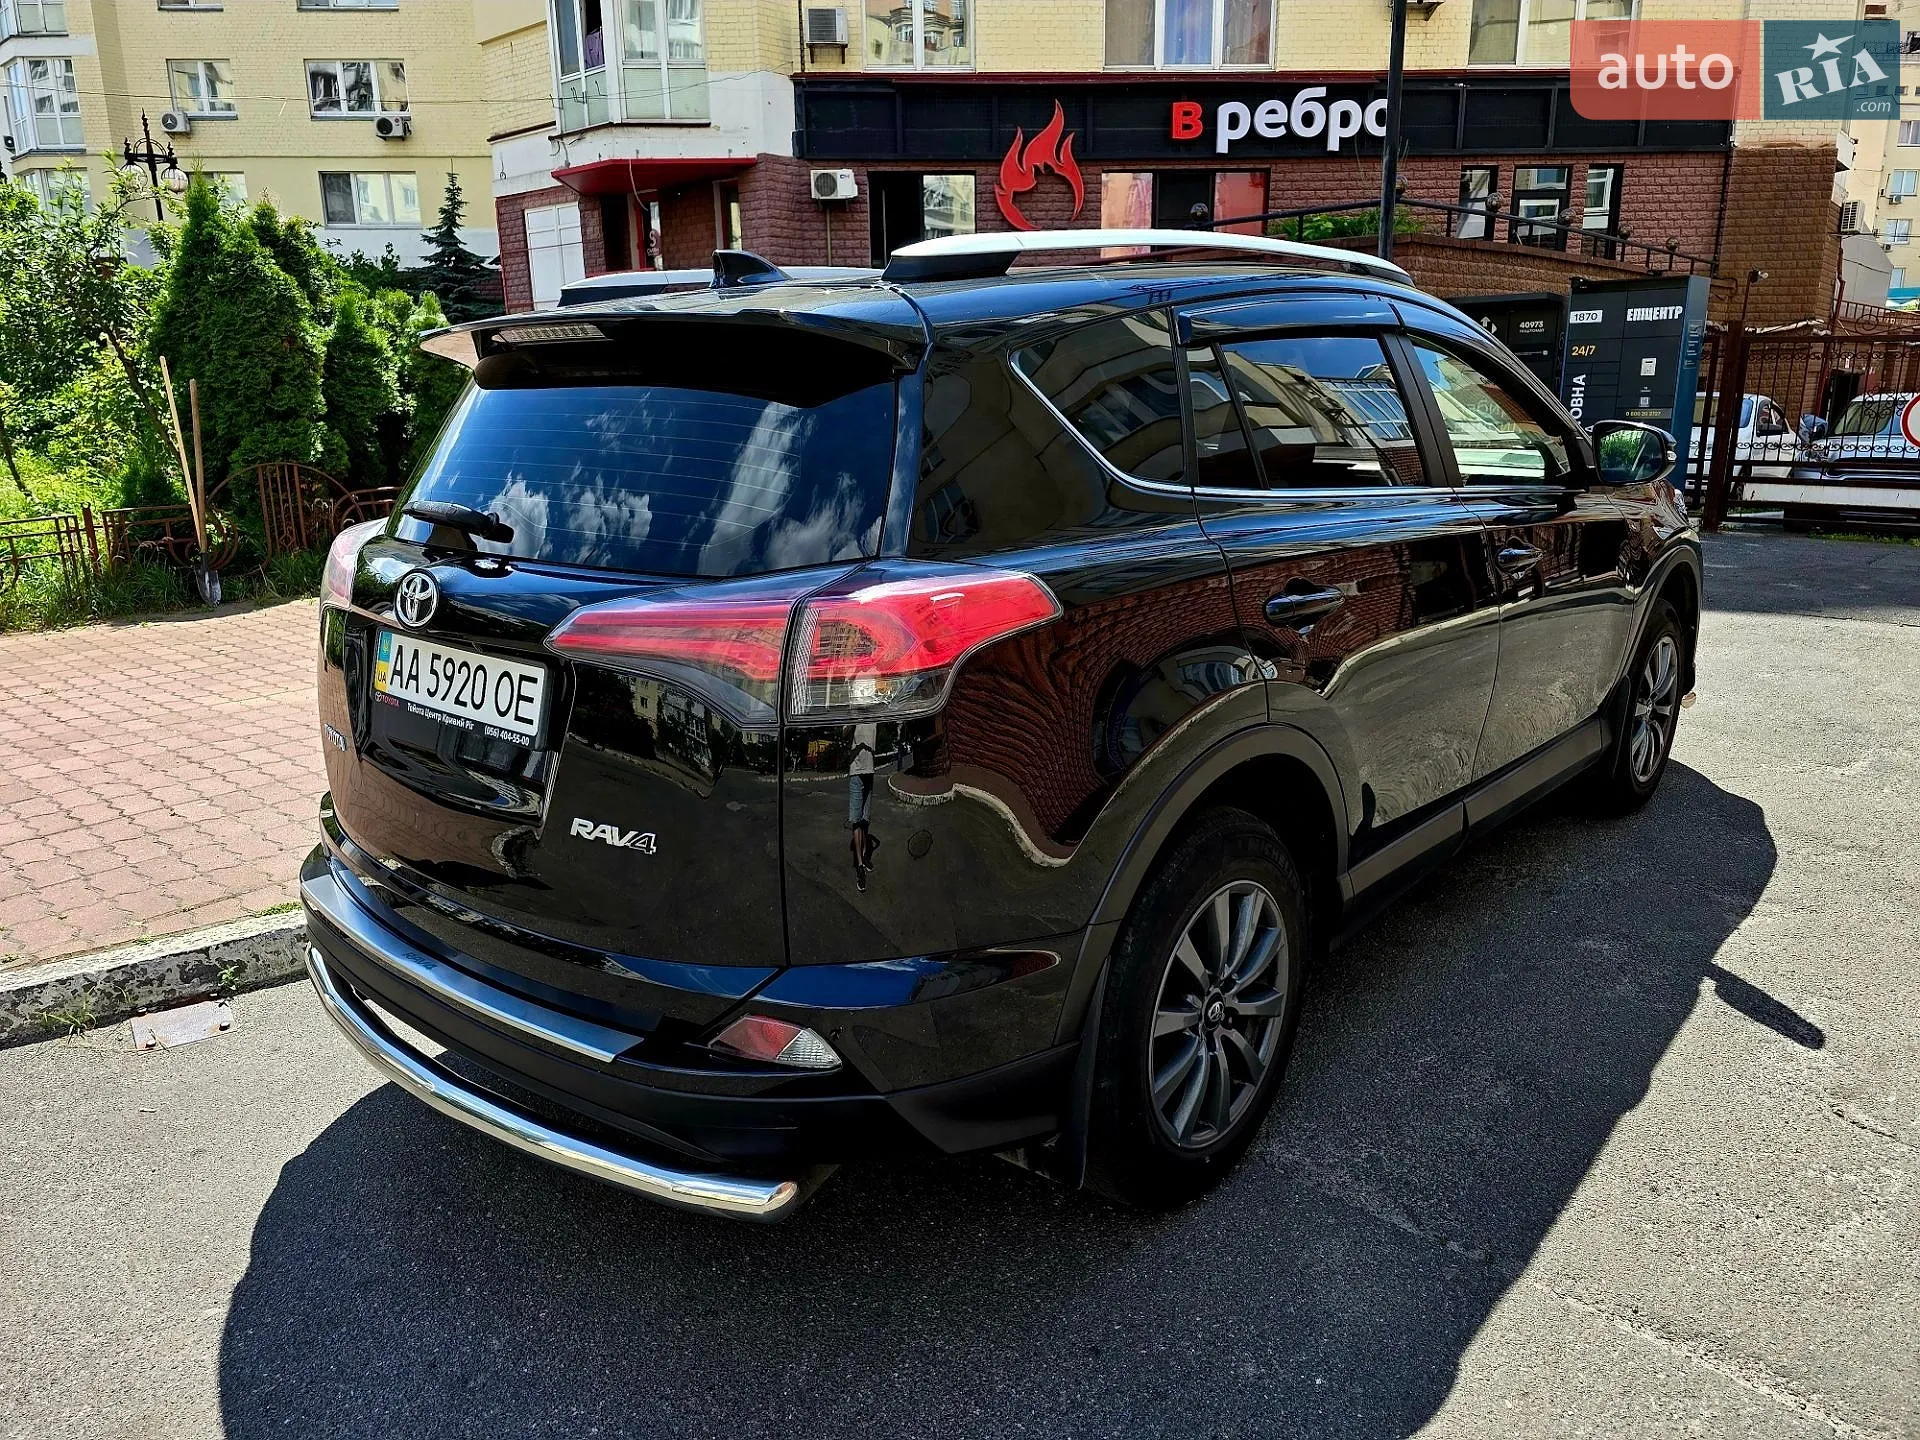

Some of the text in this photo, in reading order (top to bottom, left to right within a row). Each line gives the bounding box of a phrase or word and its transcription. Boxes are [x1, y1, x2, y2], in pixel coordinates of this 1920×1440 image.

[1215, 86, 1388, 154] ребро
[1519, 320, 1544, 329] 40973
[1574, 312, 1598, 321] 1870
[1626, 306, 1684, 322] ЕПІЦЕНТР
[1571, 345, 1596, 357] 24/7
[377, 643, 539, 726] UA AA 5920 OE
[424, 707, 442, 723] Центр
[465, 719, 475, 730] Ріг
[499, 730, 530, 746] 404-55-00
[569, 817, 657, 855] RAV4
